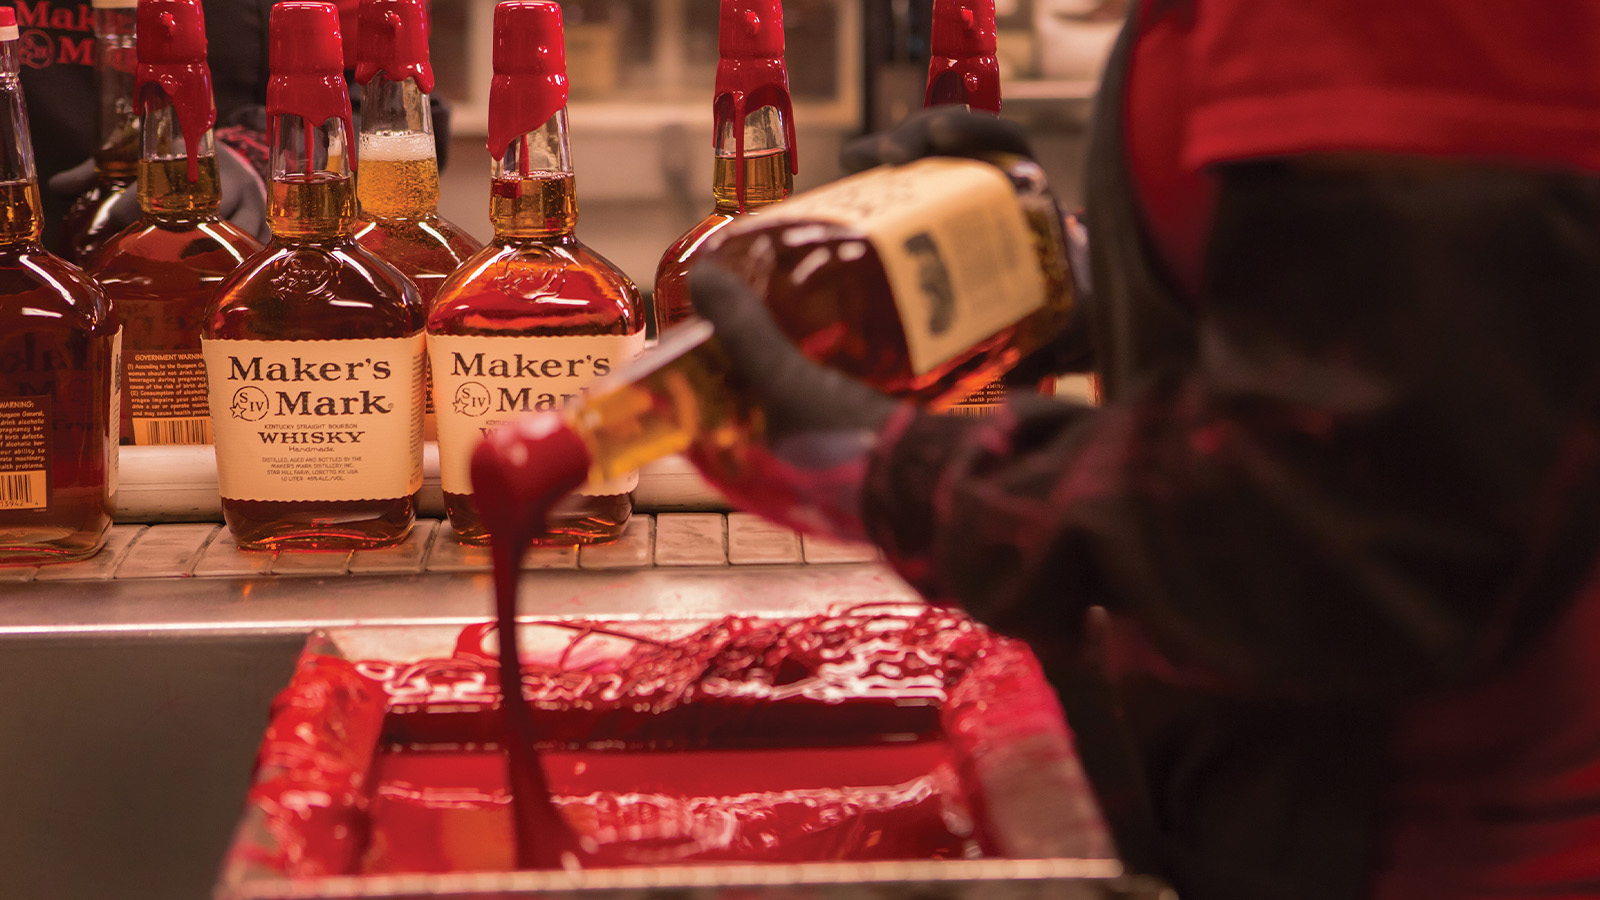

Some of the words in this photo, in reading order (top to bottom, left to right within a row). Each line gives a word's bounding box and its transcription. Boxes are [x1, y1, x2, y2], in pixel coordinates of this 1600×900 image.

[227, 356, 391, 382] Maker's
[451, 352, 611, 378] Maker's
[257, 431, 366, 444] WHISKY
